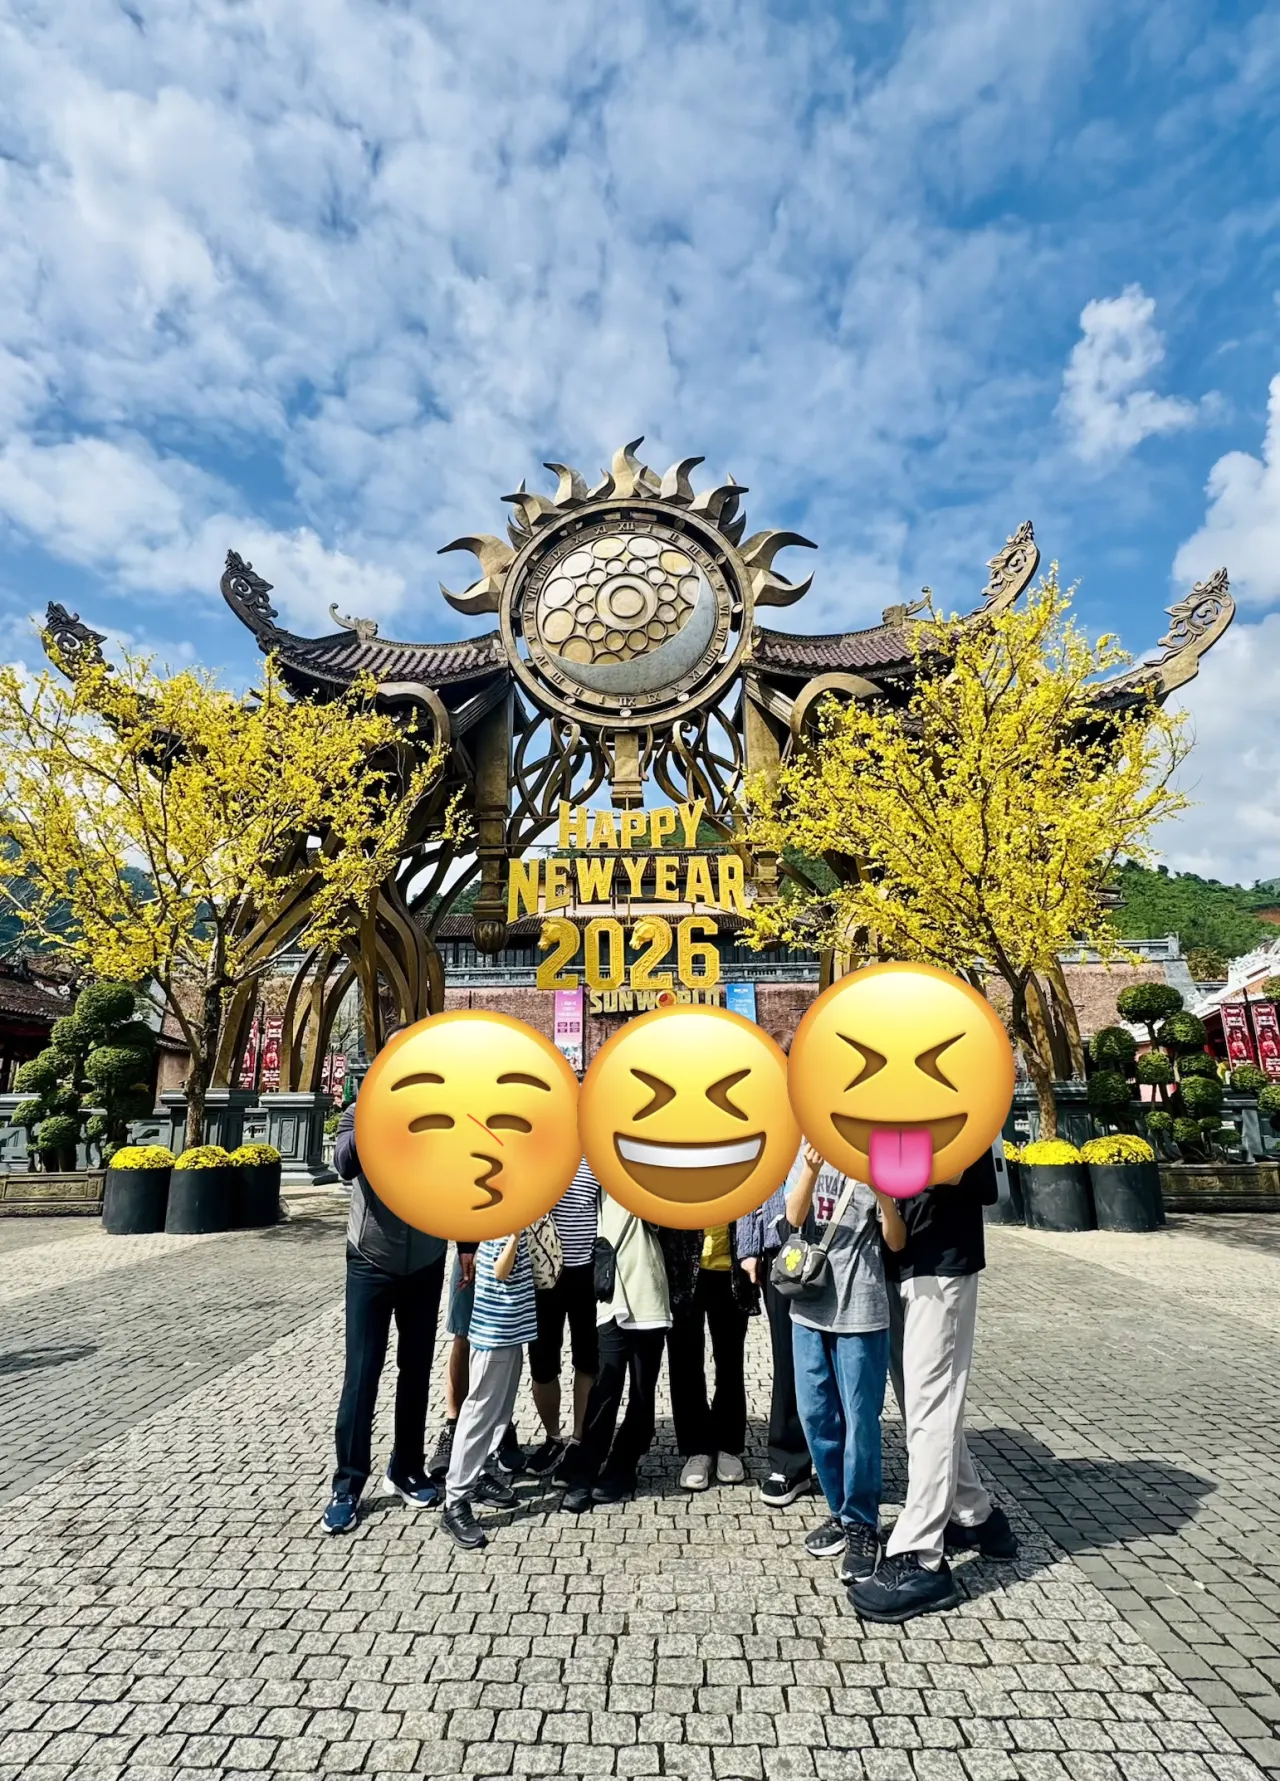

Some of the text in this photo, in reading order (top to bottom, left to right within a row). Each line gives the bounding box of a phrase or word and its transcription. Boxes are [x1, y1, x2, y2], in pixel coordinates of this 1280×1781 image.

[557, 797, 708, 850] HAPPY
[507, 854, 752, 924] NEW YEAR
[536, 916, 720, 990] 2026
